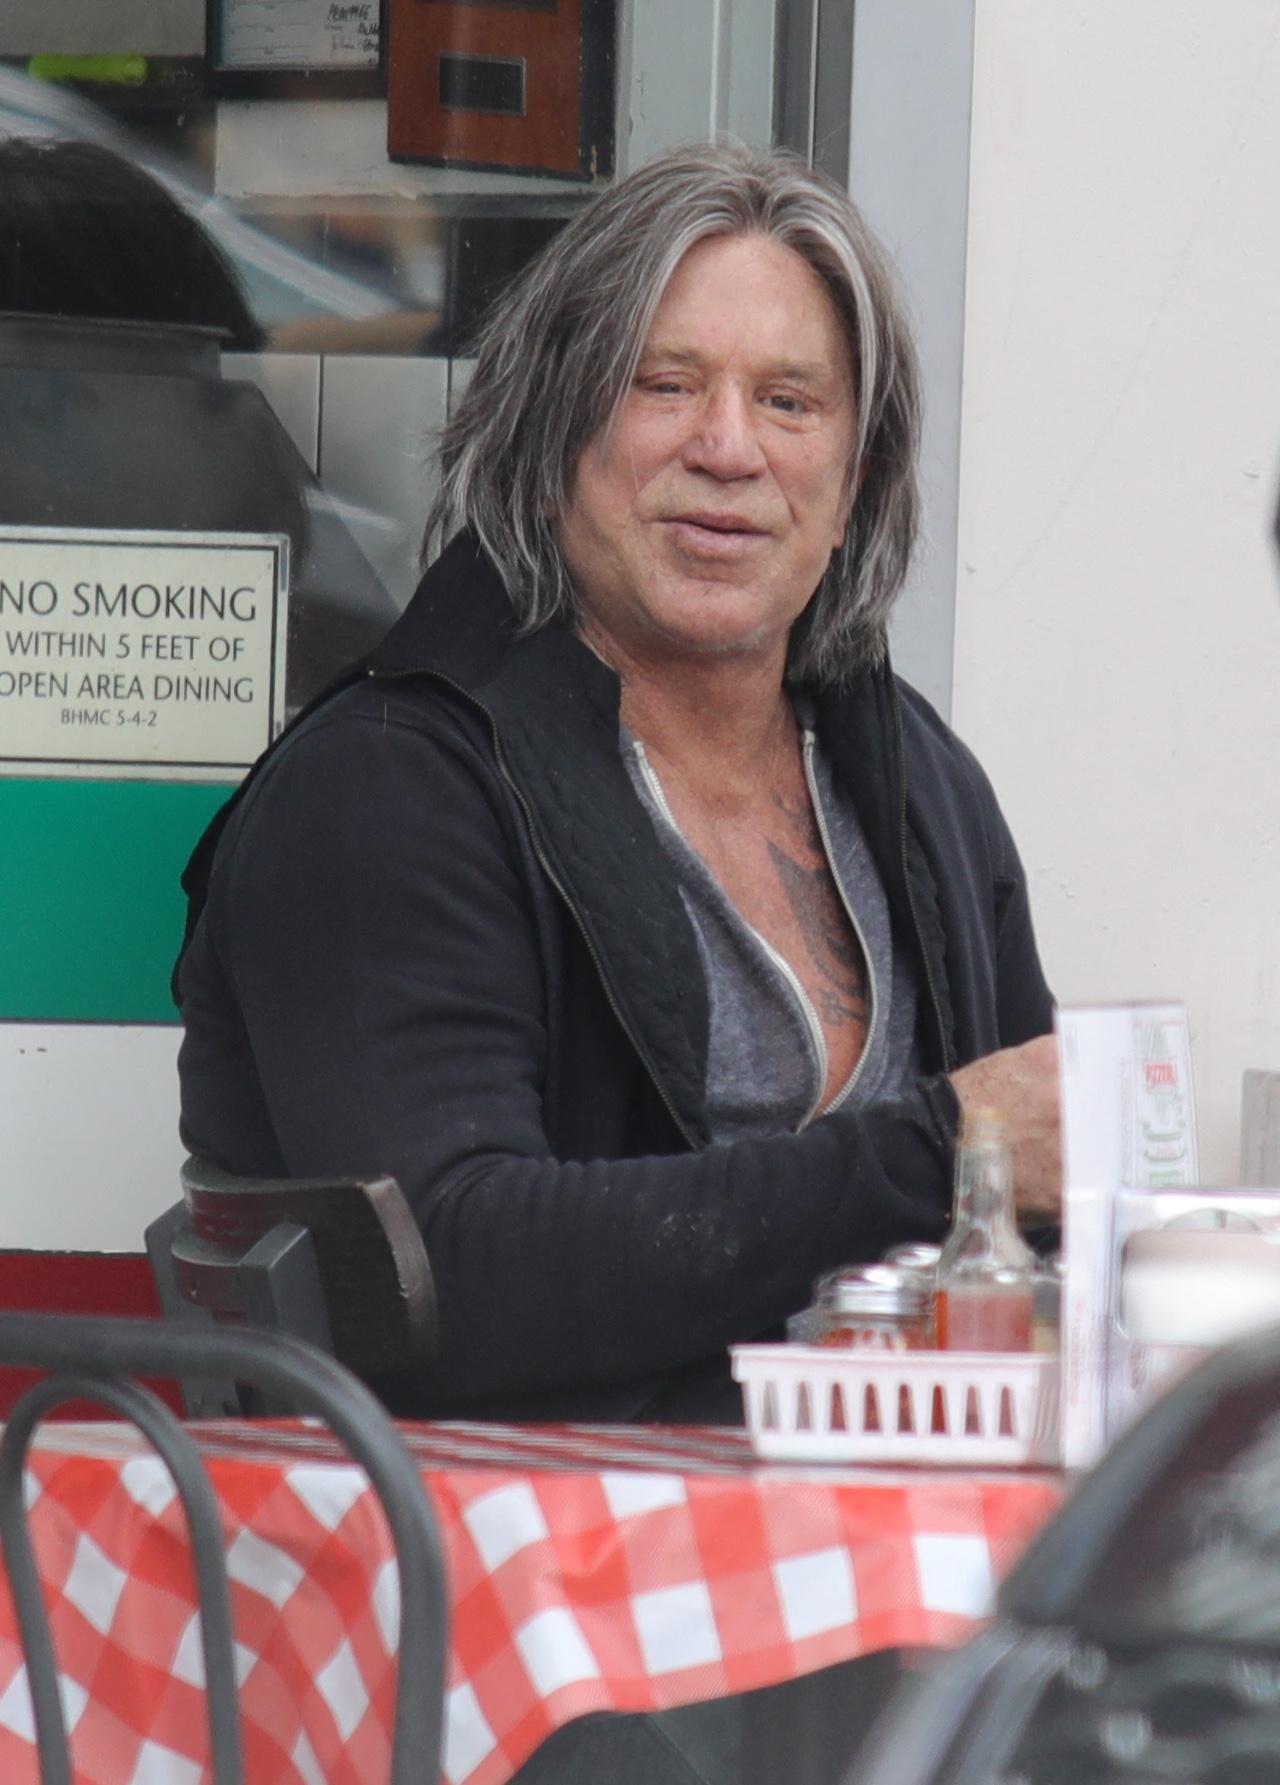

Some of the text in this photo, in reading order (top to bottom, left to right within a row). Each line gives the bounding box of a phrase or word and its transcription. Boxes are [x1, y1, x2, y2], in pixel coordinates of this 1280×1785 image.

[0, 580, 256, 622] NO SMOKING
[5, 630, 245, 662] WITHIN 5 FEET OF
[0, 671, 254, 703] OPEN AREA DINING
[60, 708, 158, 727] BHMC 5-4-2
